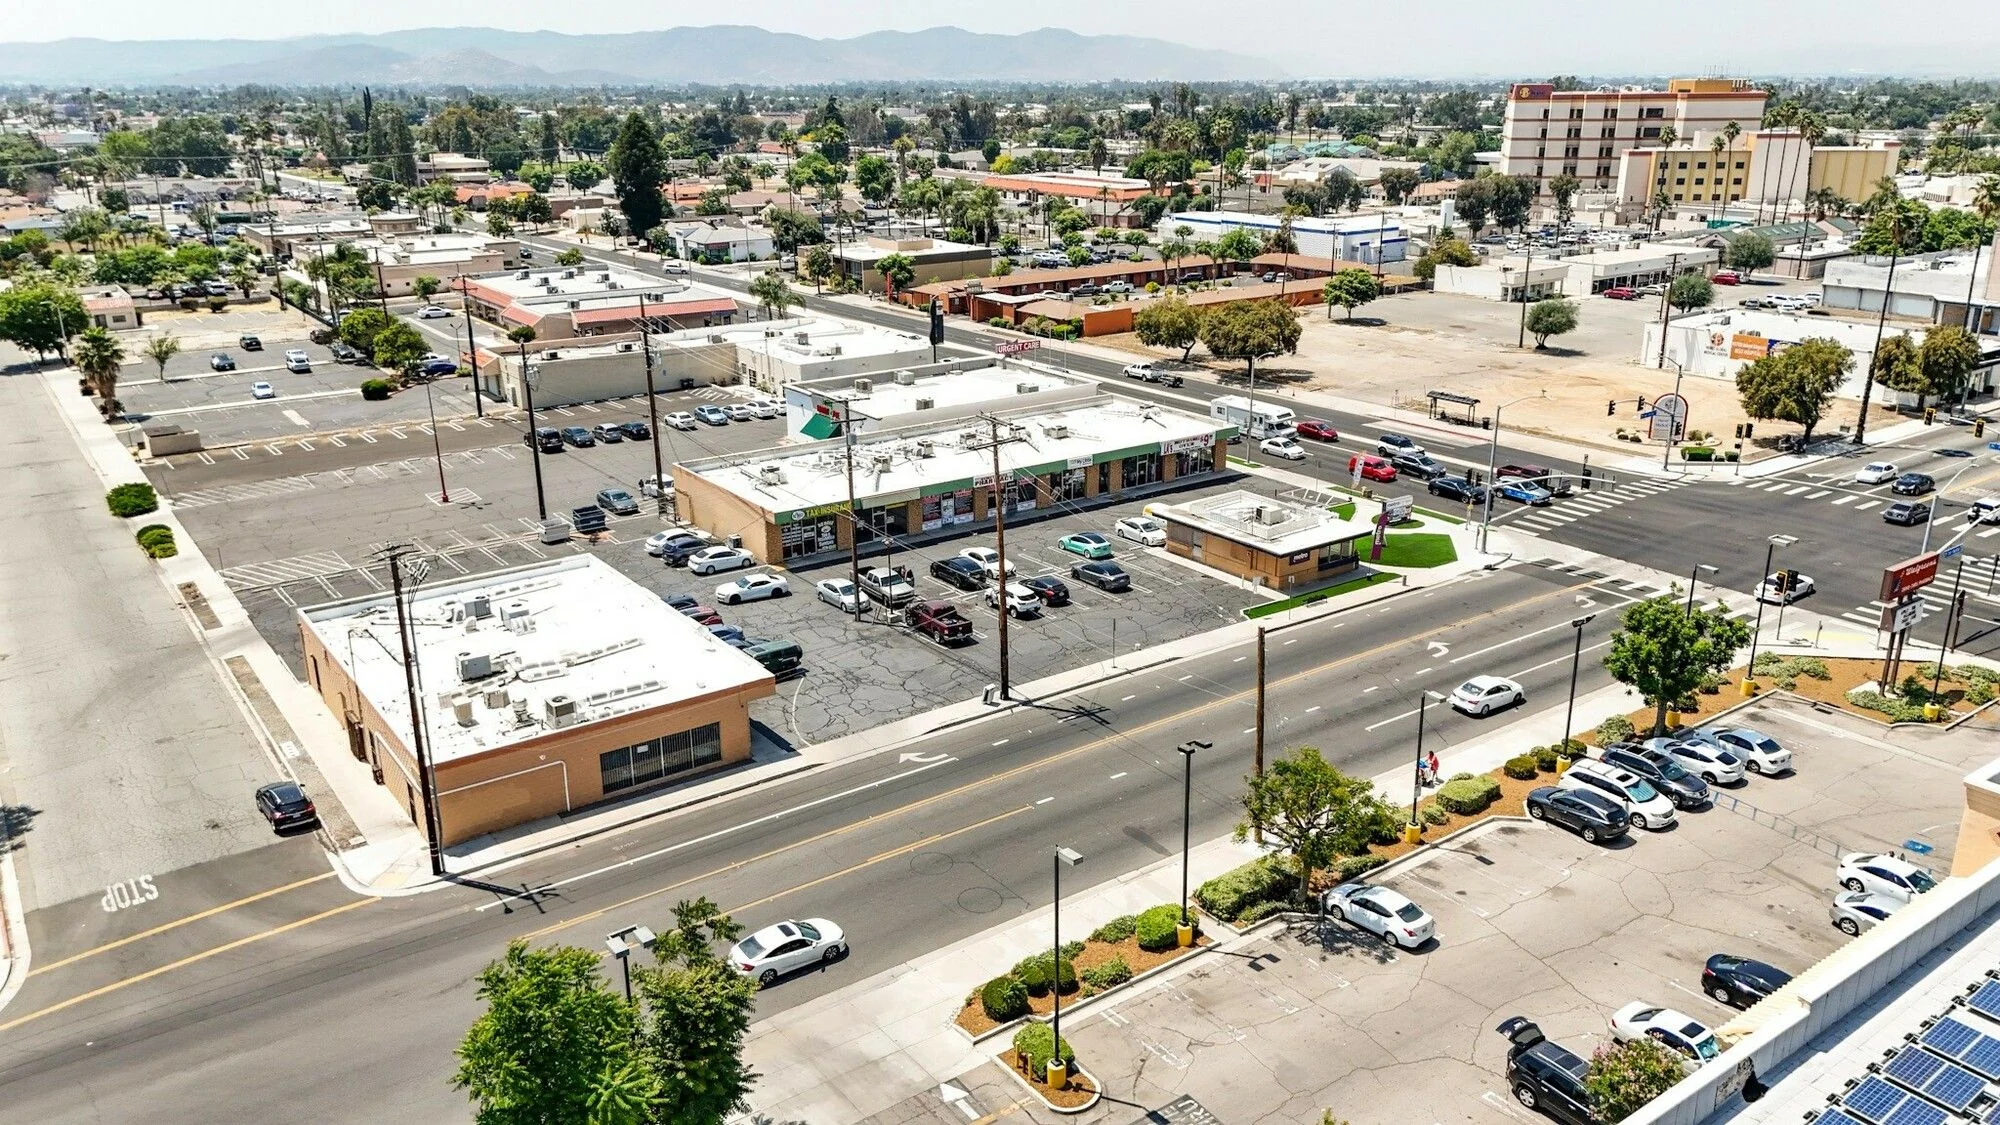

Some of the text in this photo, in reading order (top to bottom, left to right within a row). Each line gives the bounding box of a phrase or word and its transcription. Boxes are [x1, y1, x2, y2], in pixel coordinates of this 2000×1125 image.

[998, 340, 1040, 353] URGENT CARE
[975, 476, 1013, 486] PHARACY
[806, 506, 819, 517] TAX
[1375, 525, 1383, 546] metro
[1293, 551, 1309, 562] metro
[1905, 560, 1936, 575] Walgreens
[101, 874, 159, 912] STOP
